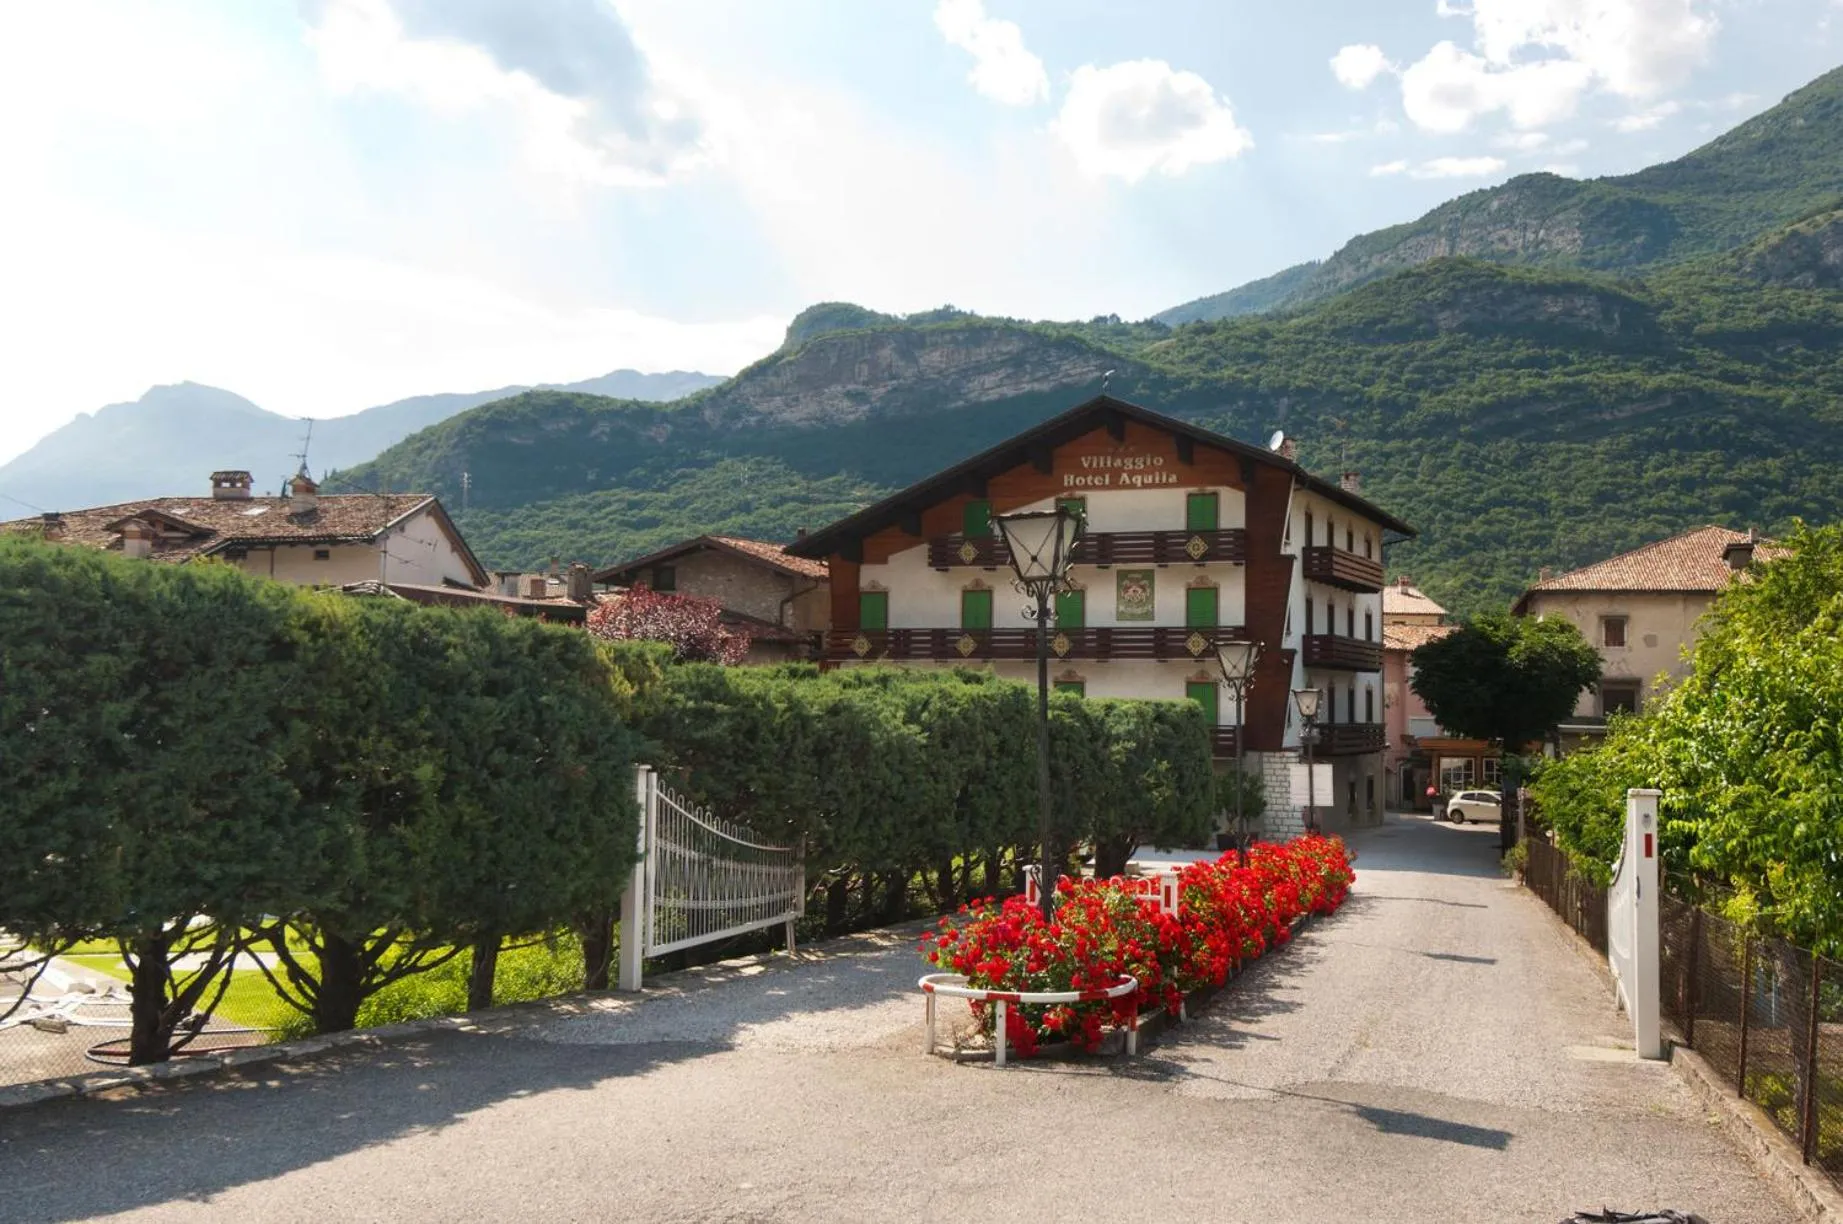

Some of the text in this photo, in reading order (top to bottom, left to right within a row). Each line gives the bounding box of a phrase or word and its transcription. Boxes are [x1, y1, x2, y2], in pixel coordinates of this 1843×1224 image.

[1081, 453, 1164, 470] Villaggio
[1063, 472, 1179, 488] Hotel Aquila
